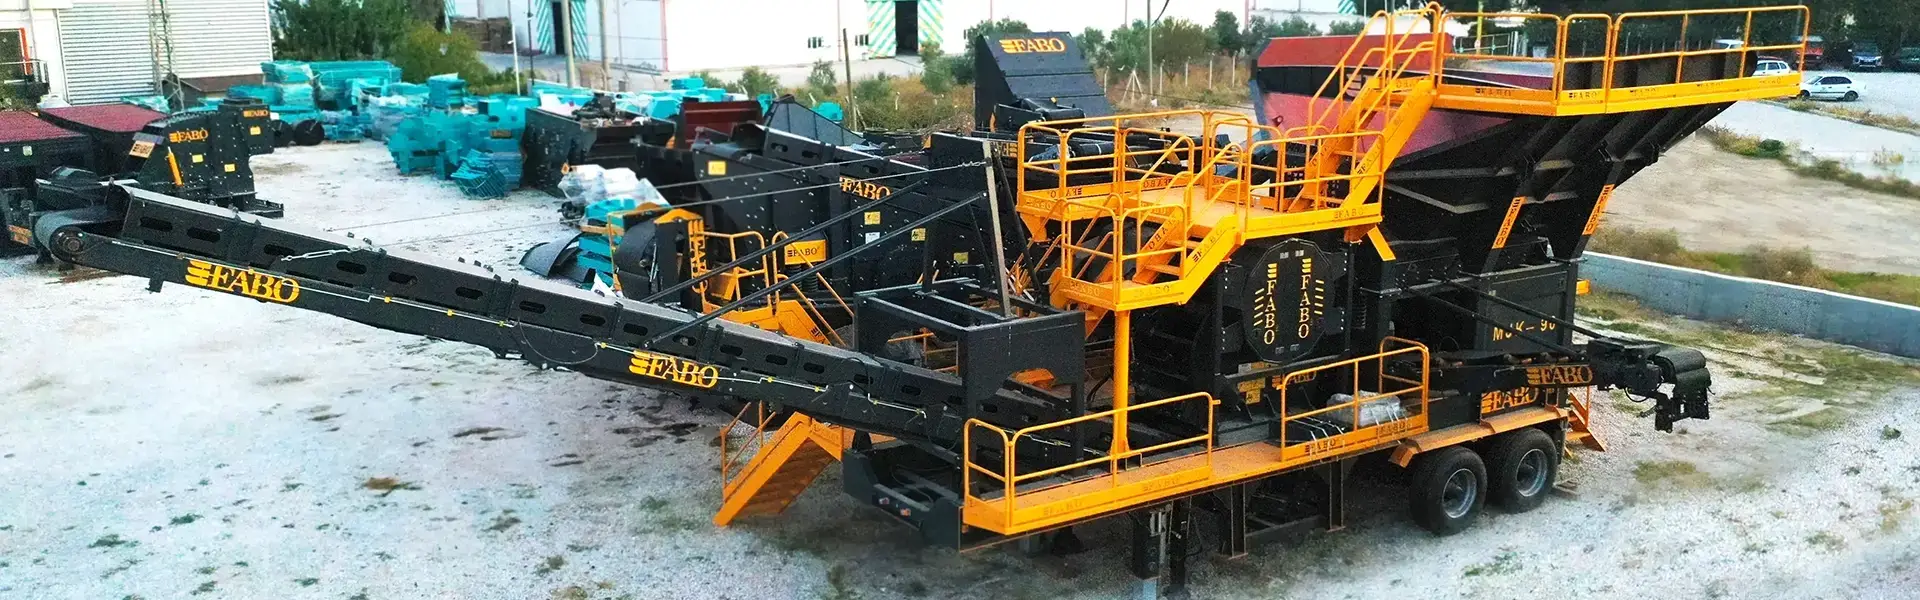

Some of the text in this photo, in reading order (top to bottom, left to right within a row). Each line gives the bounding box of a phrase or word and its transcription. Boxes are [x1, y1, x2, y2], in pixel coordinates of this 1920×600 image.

[1012, 37, 1066, 53] FABO
[179, 129, 209, 142] FABO
[843, 178, 891, 200] FABO
[207, 265, 300, 303] FABO
[1264, 280, 1277, 345] FABO
[1298, 274, 1311, 339] FABO
[648, 356, 719, 388] FABO
[1541, 366, 1593, 384] FABO
